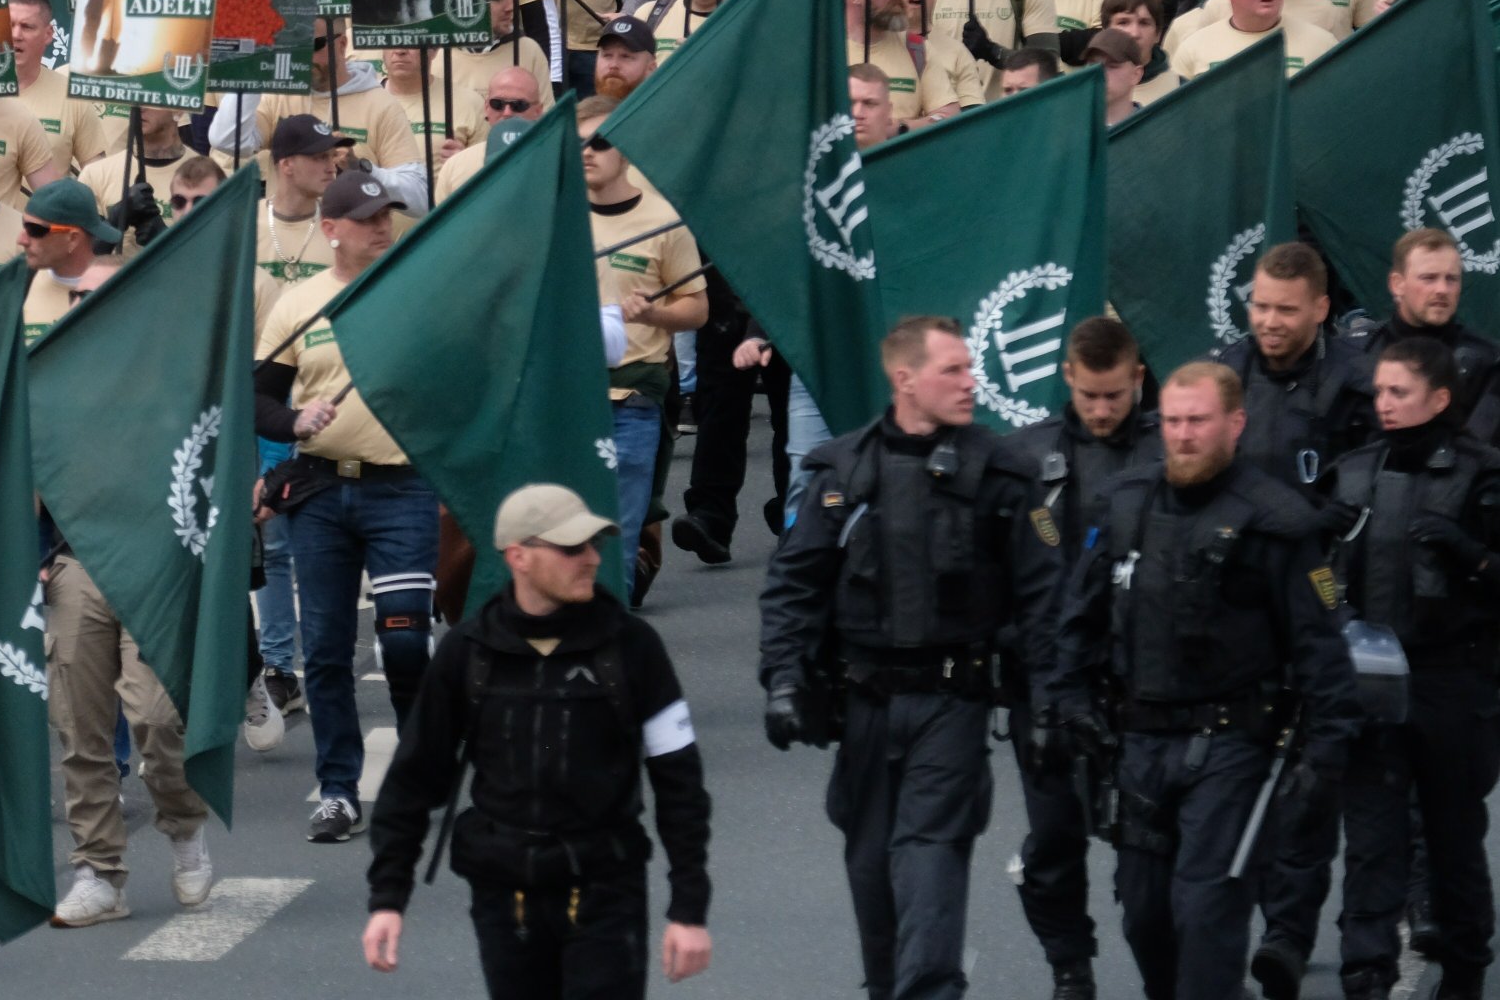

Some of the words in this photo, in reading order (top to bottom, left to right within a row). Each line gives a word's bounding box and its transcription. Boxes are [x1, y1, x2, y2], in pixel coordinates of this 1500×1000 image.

[355, 35, 387, 46] DER
[392, 33, 449, 46] DRITTE
[452, 31, 490, 43] WEG
[70, 84, 101, 96] DER
[105, 87, 162, 104] DRITTE
[165, 93, 201, 109] WEG
